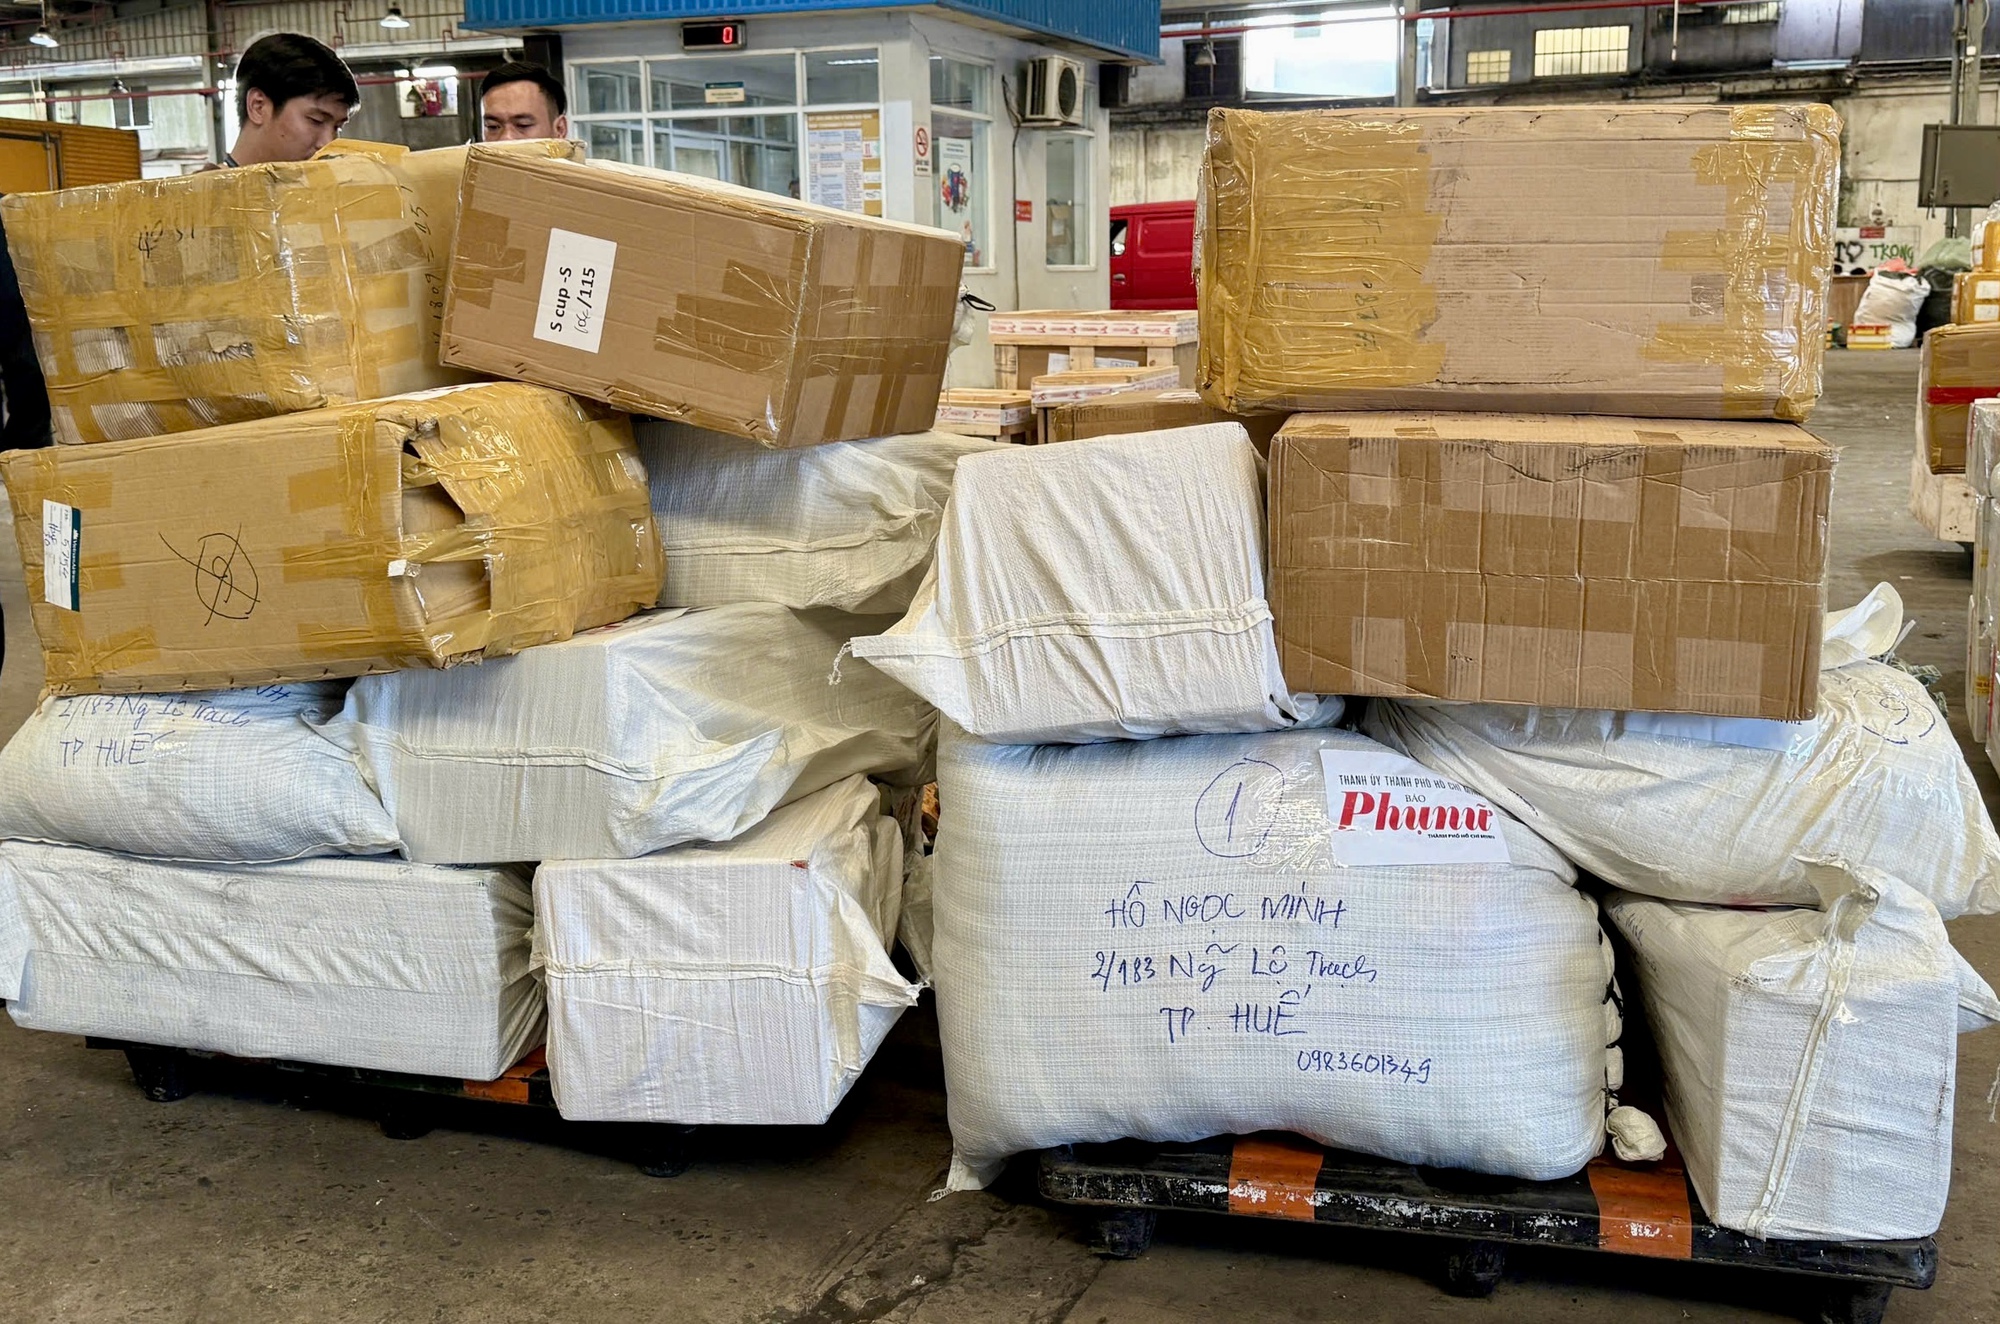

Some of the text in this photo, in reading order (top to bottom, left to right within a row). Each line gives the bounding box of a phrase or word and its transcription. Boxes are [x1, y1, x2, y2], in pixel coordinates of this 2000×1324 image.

[723, 26, 733, 44] 0
[555, 287, 571, 318] cup
[550, 321, 563, 333] S
[1091, 951, 1157, 992] 2/183
